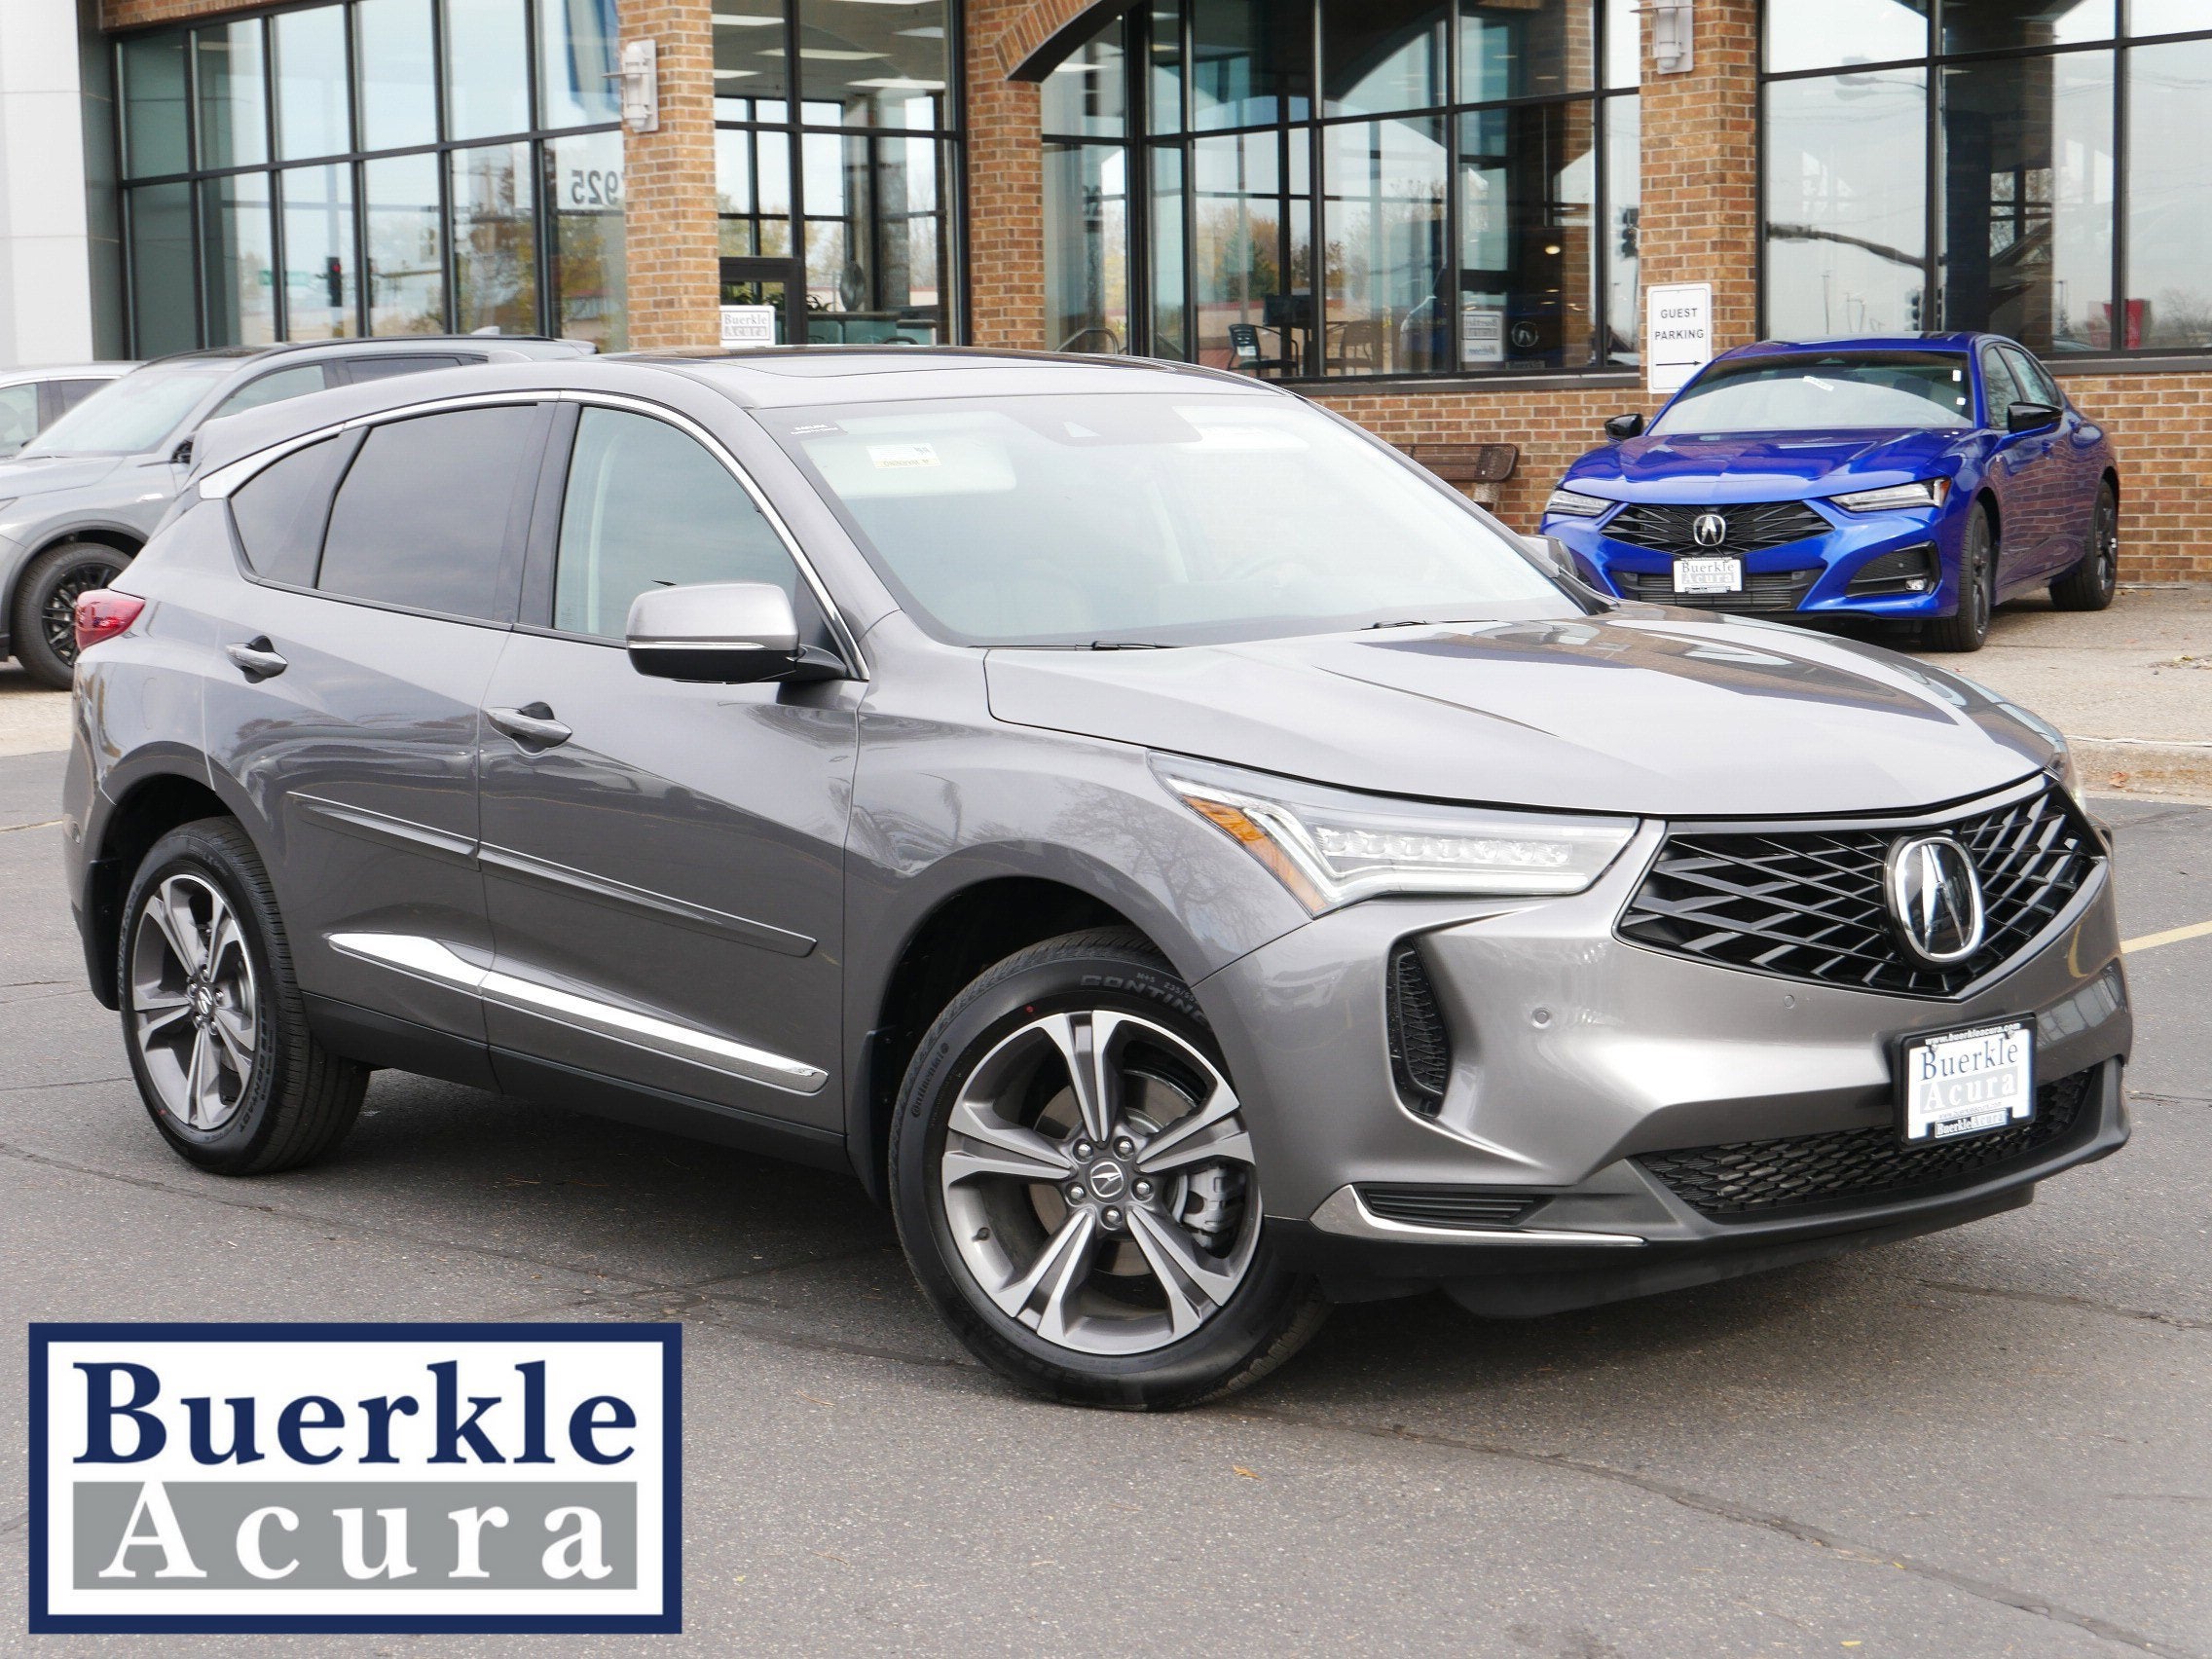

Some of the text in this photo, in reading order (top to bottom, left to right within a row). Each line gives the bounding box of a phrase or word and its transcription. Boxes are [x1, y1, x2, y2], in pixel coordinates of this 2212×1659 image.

[724, 313, 768, 325] Buerkle
[1660, 308, 1698, 319] GUEST
[1654, 329, 1705, 341] PARKING
[1681, 561, 1734, 573] Buerkle
[1682, 572, 1734, 584] Acura
[1921, 1037, 2018, 1081] Buerkle
[1924, 1072, 2016, 1111] Acura
[1936, 1112, 2005, 1135] Buerkle Acura
